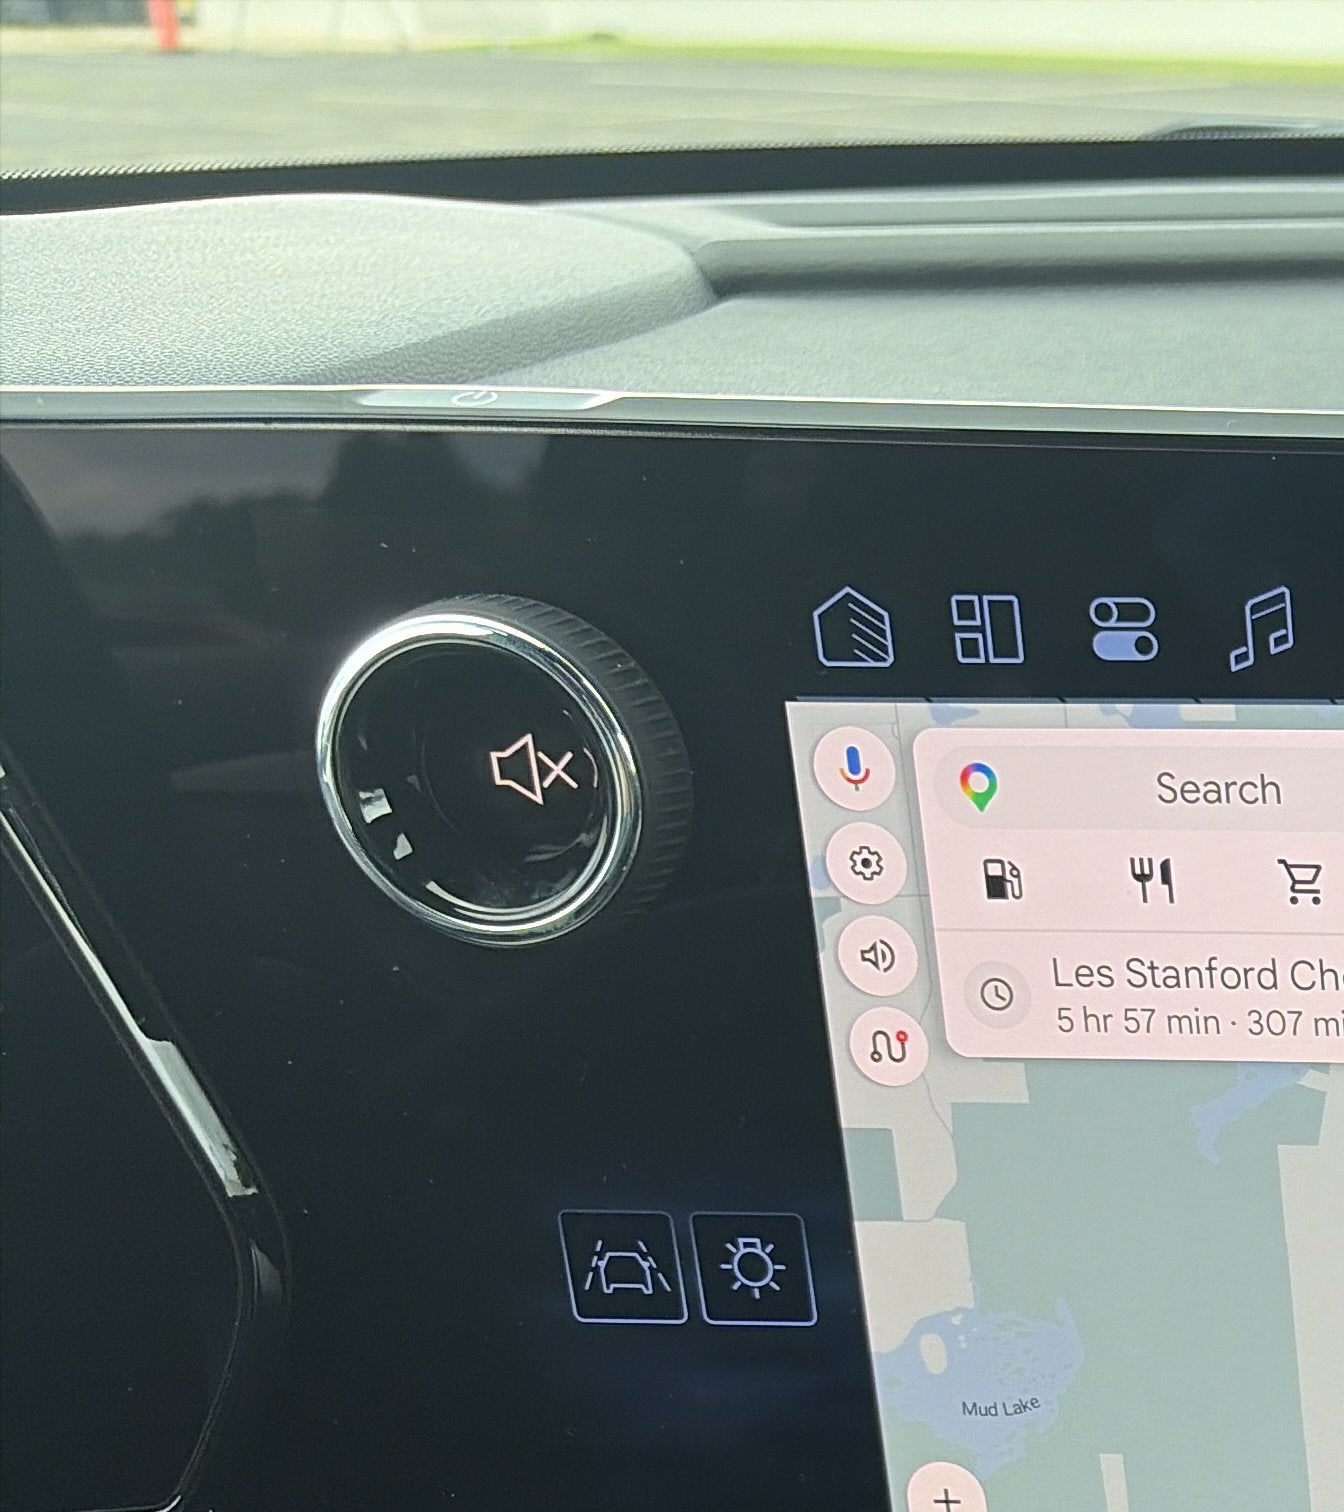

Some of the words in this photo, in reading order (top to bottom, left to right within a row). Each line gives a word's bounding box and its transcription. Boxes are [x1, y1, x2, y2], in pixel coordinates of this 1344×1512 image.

[1156, 772, 1282, 805] Search
[1053, 957, 1115, 989] Les
[1126, 957, 1278, 991] Stanford
[1057, 1009, 1074, 1033] 5
[1081, 1007, 1114, 1034] hr
[1124, 1010, 1158, 1035] 57
[1167, 1010, 1221, 1036] min
[1247, 1011, 1304, 1038] 307
[961, 1402, 998, 1418] Mud
[1001, 1396, 1041, 1417] Lake
